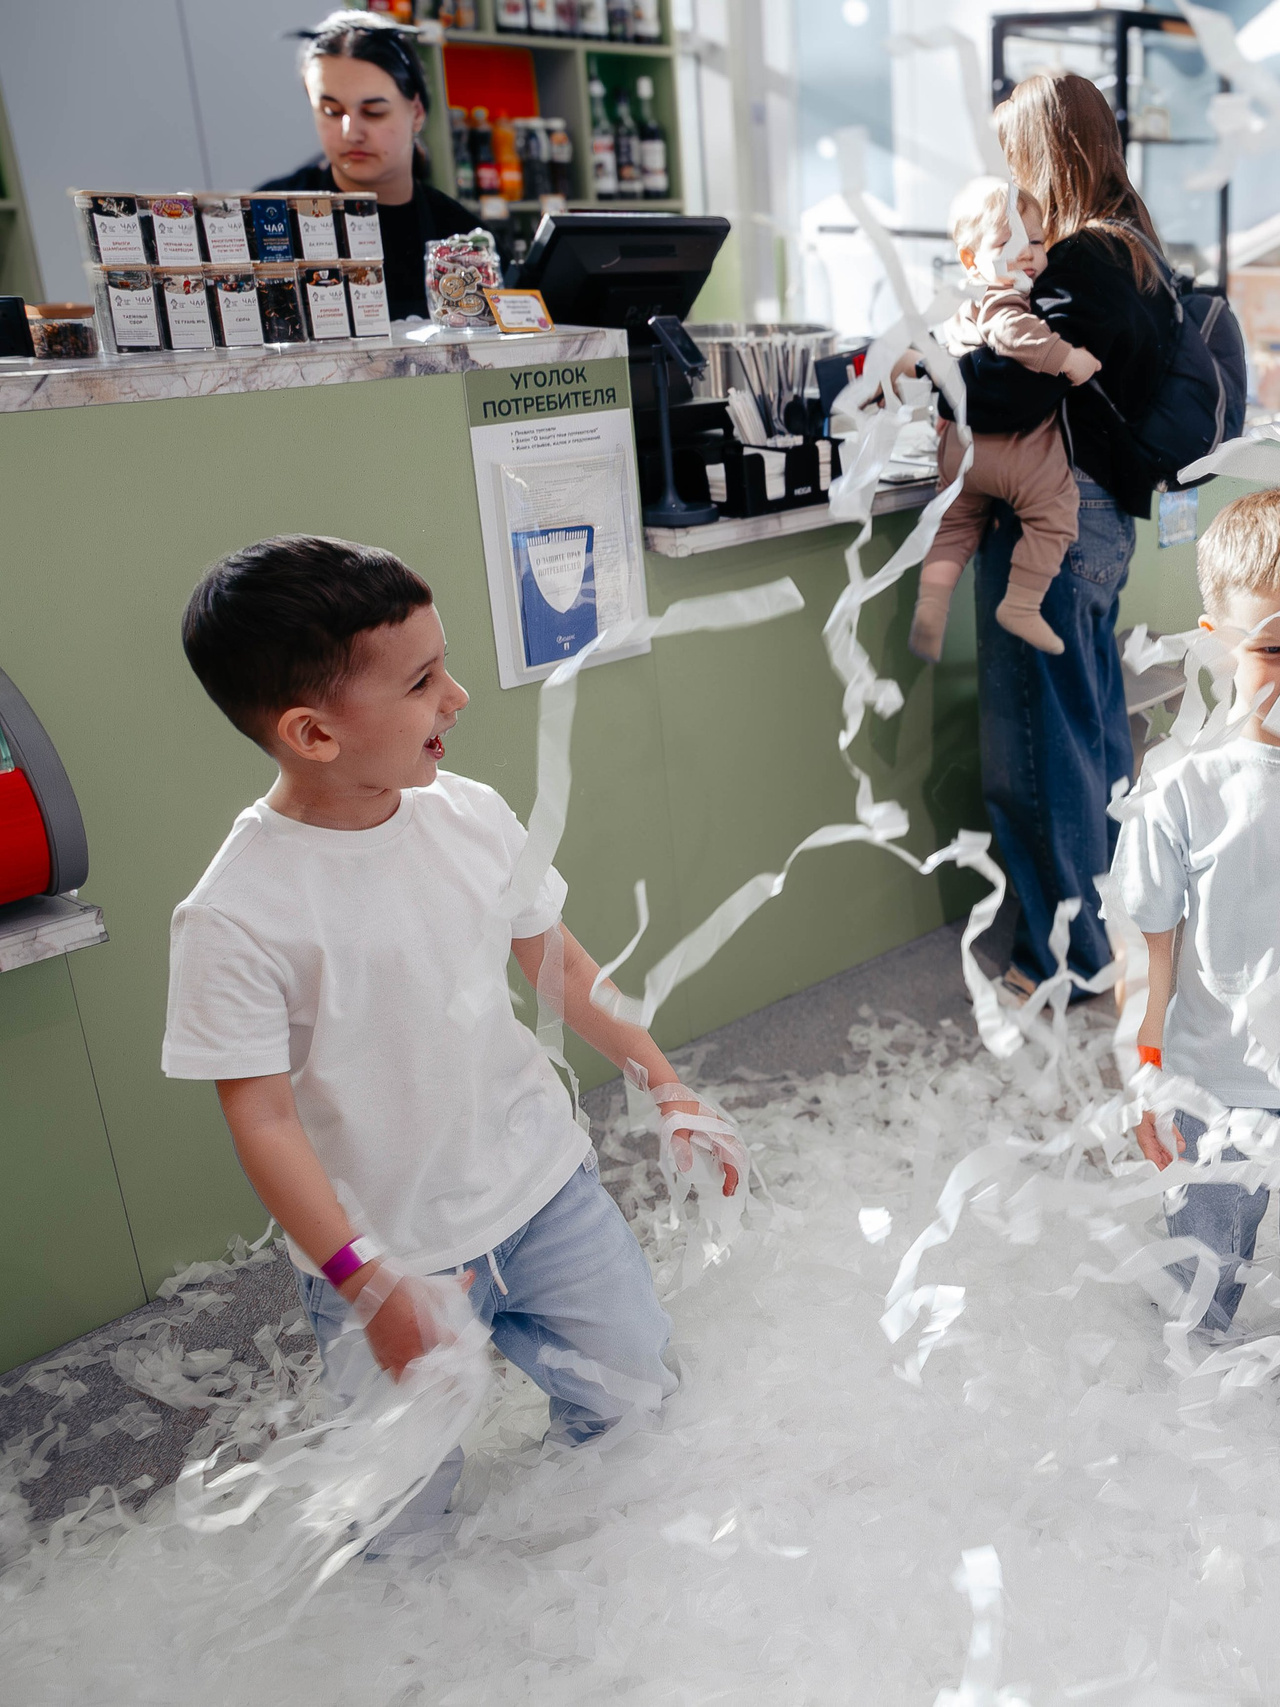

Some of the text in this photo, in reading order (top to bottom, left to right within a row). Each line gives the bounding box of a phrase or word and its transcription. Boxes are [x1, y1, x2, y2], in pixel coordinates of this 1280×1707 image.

[264, 222, 285, 233] ЧАЙ
[510, 366, 587, 390] УГОЛОК
[482, 387, 617, 419] ПОТРЕБИТЕЛЯ
